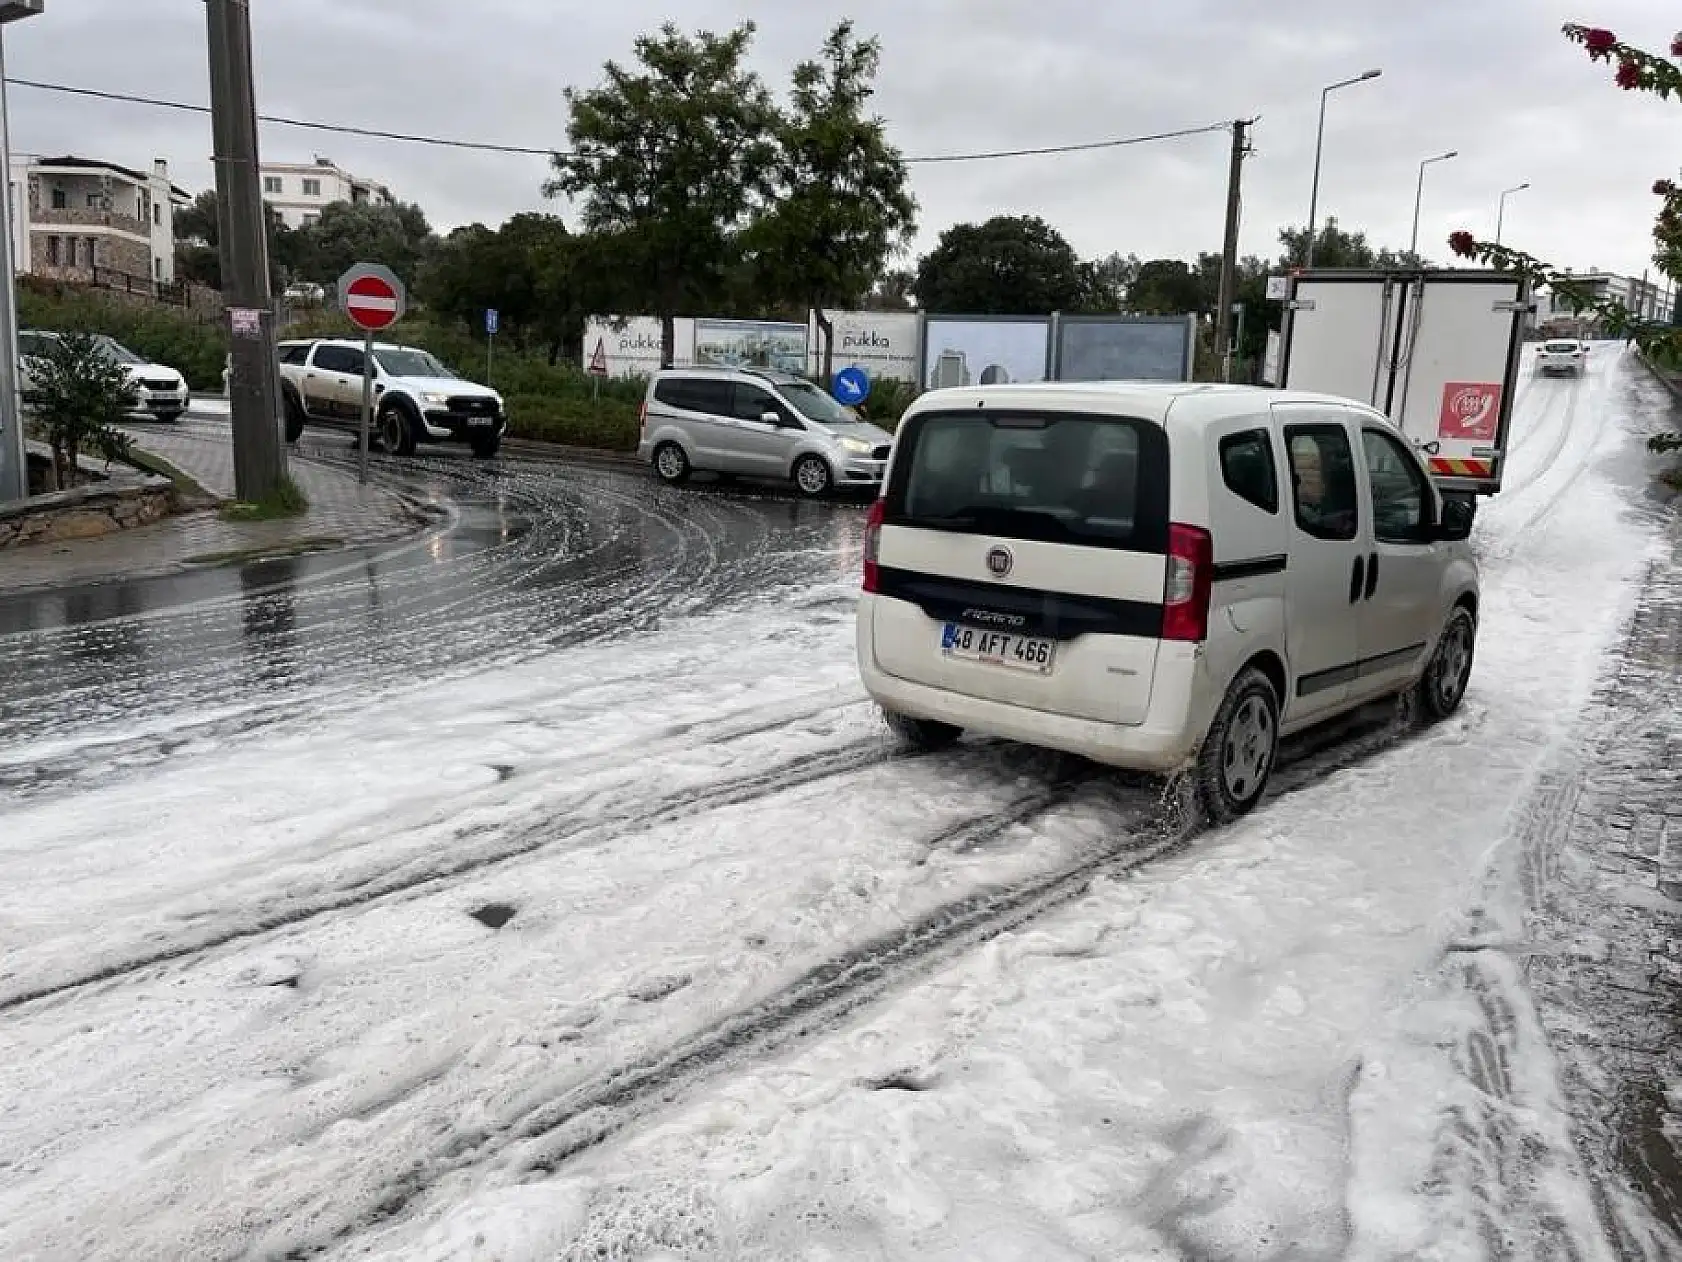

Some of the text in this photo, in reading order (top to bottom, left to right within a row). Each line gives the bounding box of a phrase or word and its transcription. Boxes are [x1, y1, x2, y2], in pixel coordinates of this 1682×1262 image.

[844, 330, 890, 348] pukka
[954, 627, 972, 650] 48
[979, 632, 1011, 655] AFT
[1014, 637, 1050, 663] 466
